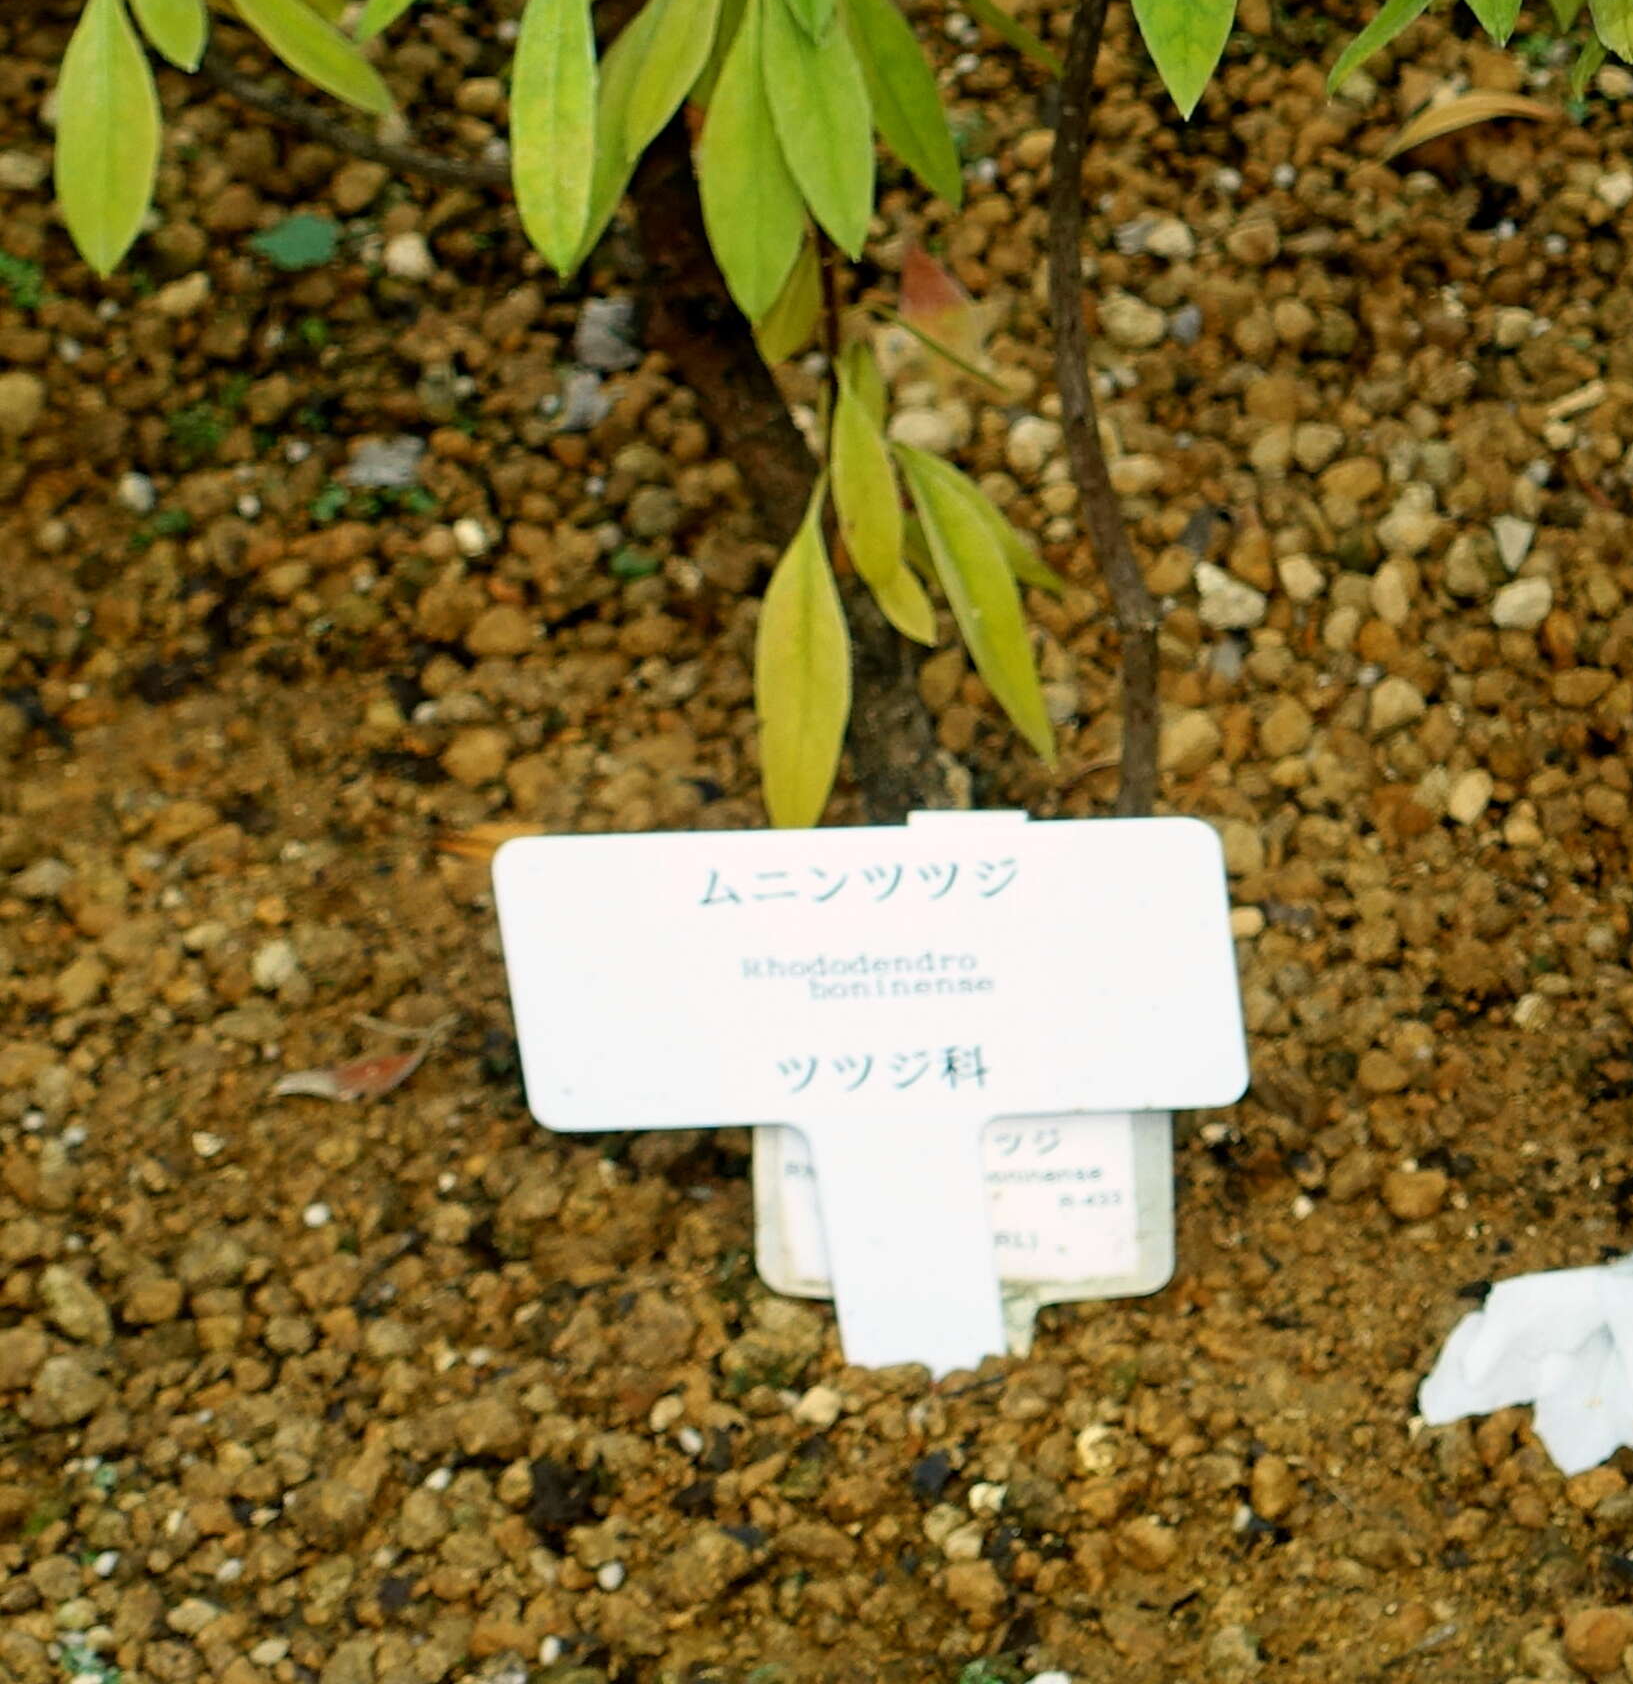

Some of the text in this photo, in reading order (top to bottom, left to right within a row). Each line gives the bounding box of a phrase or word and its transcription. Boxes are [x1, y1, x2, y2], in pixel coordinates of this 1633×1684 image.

[698, 856, 1019, 906] ムニンツツジ
[741, 951, 978, 979] Rhododendro
[809, 977, 995, 1000] boninense
[776, 1044, 990, 1094] ツツジ科
